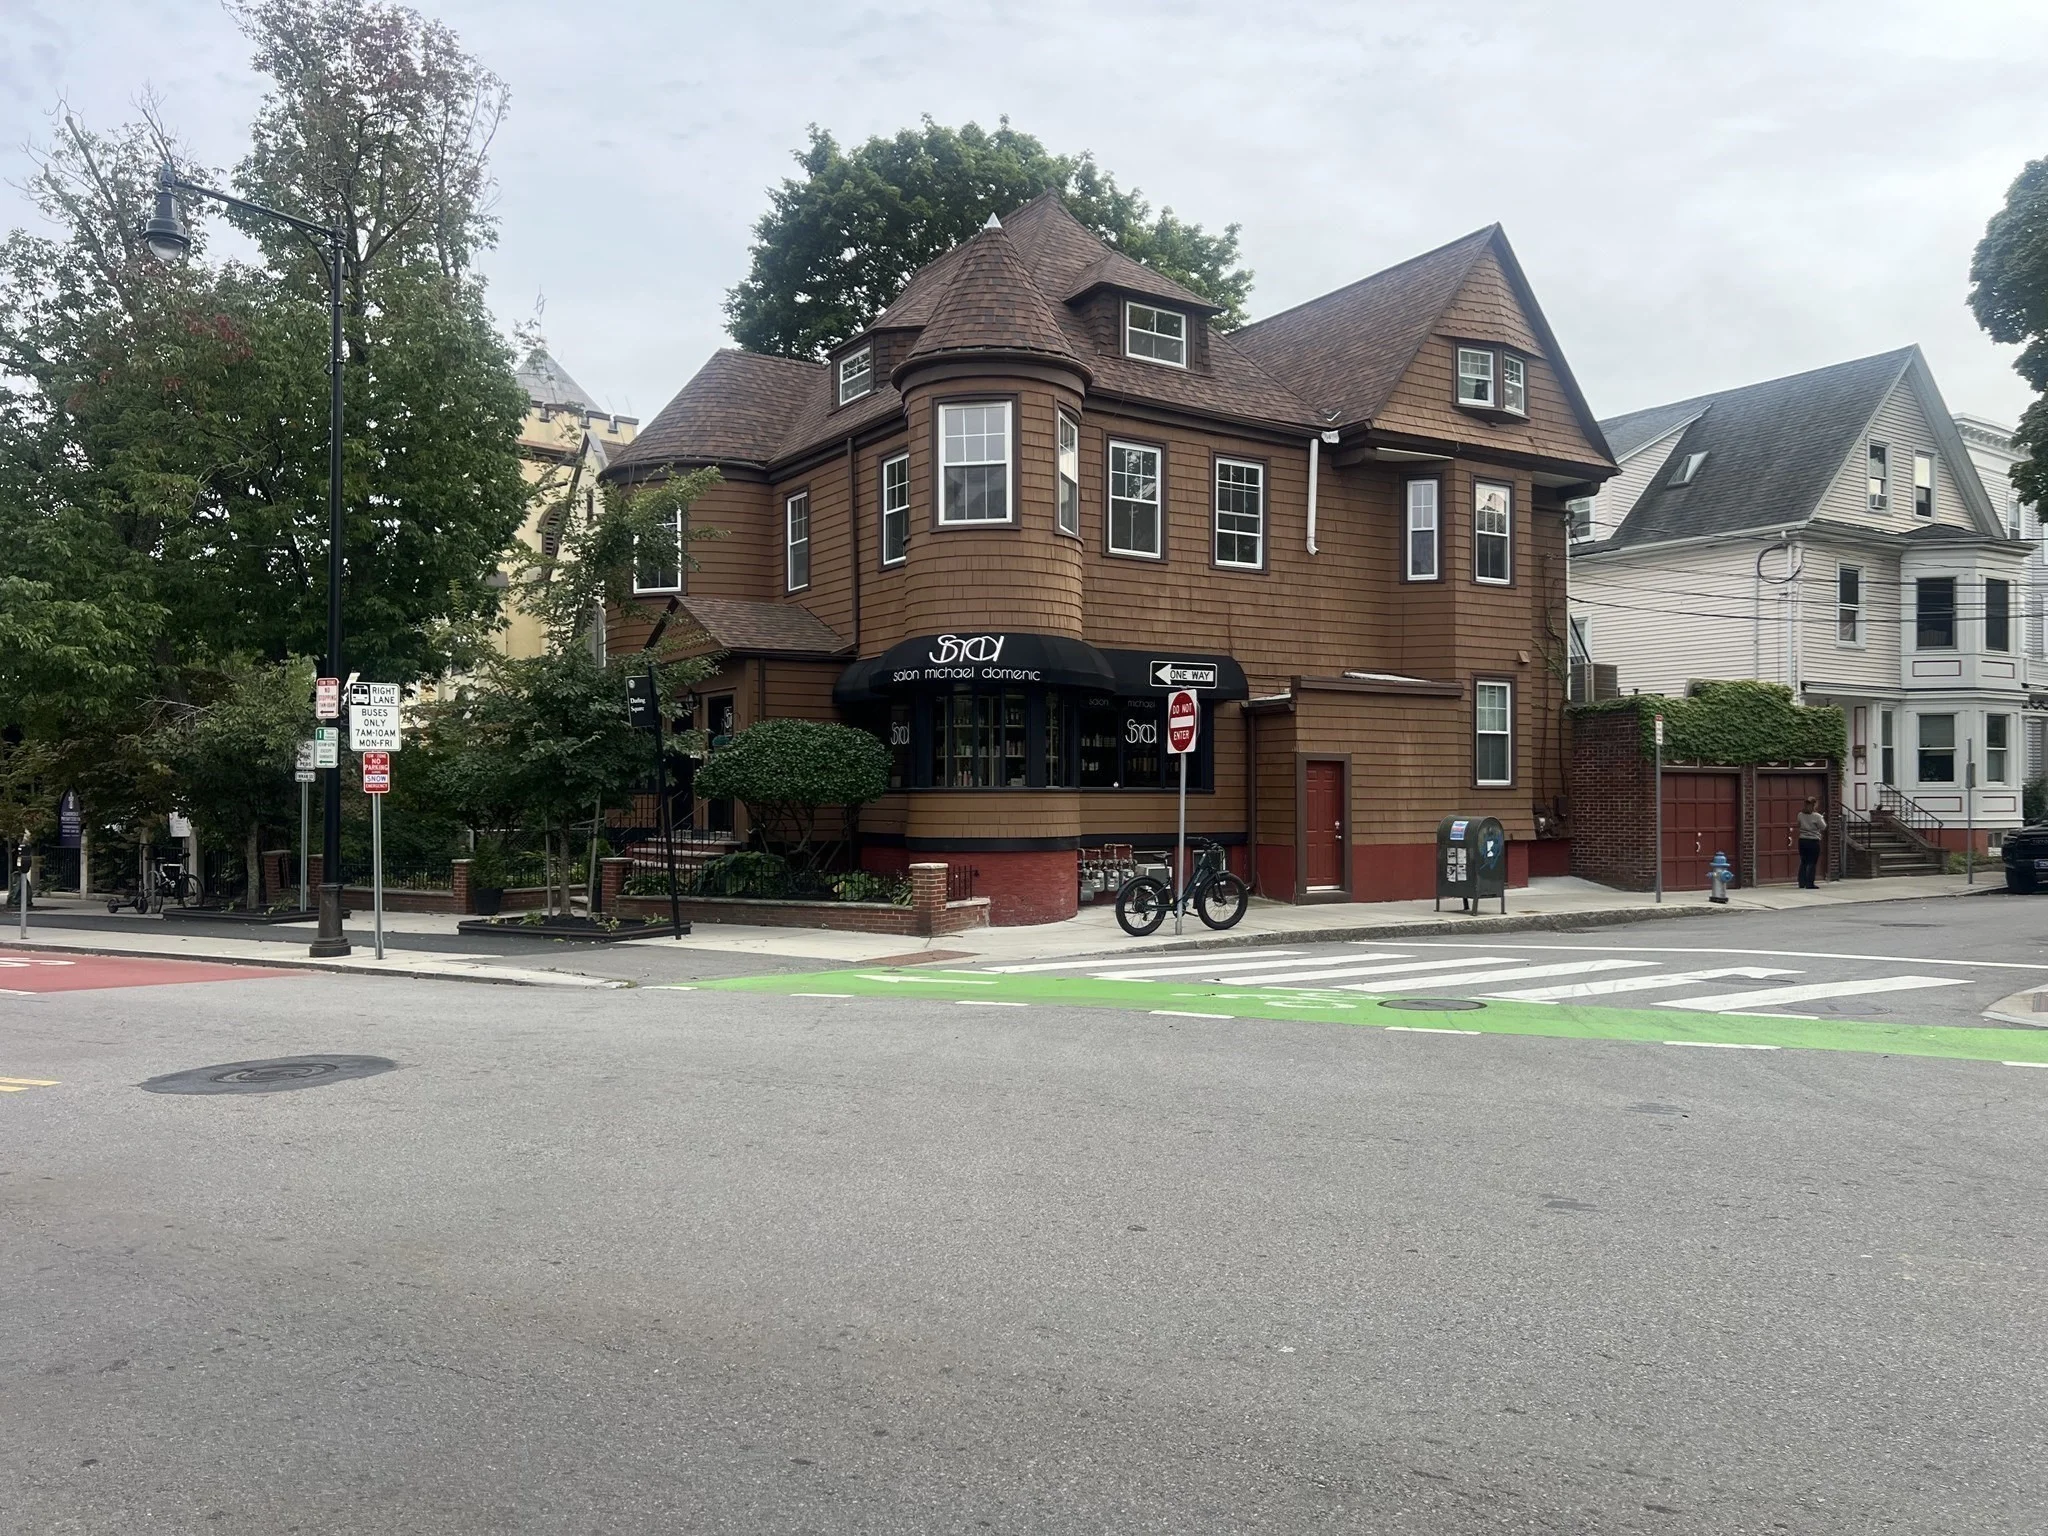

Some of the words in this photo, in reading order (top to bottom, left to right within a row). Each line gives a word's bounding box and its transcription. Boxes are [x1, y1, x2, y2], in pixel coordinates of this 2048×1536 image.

[893, 669, 919, 682] salon
[925, 666, 975, 679] michael
[982, 667, 1041, 681] domenic
[1170, 670, 1187, 679] ONE
[1192, 671, 1210, 680] WAY
[372, 686, 396, 695] RIGHT
[373, 696, 395, 704] LANE
[361, 708, 388, 717] BUSES
[1172, 705, 1180, 714] DO
[1181, 702, 1192, 713] NOT
[363, 718, 386, 727] ONLY
[355, 728, 396, 737] 7AM-10AM
[1173, 730, 1190, 741] ENTER
[359, 739, 393, 747] MON-FRI
